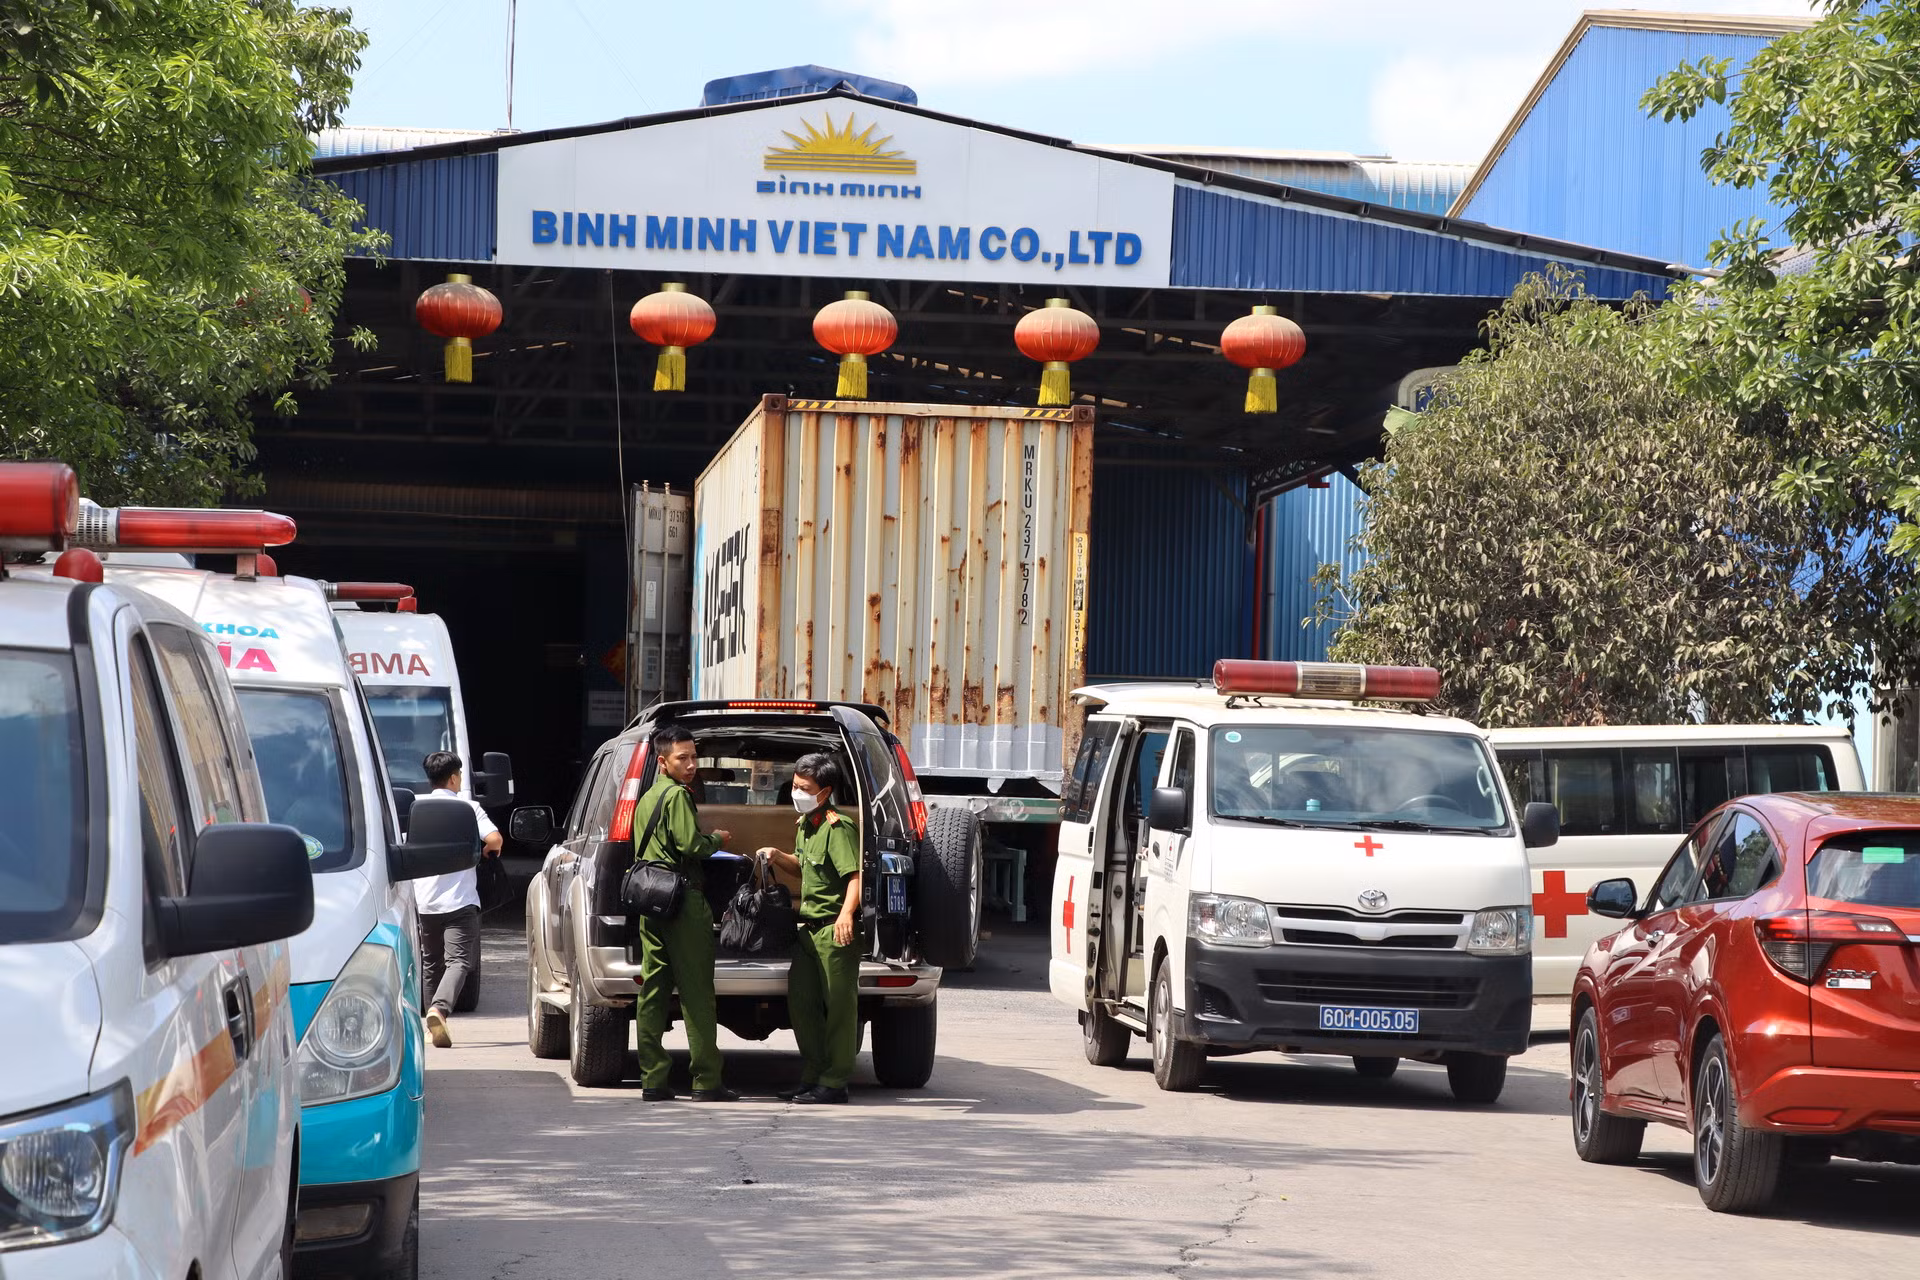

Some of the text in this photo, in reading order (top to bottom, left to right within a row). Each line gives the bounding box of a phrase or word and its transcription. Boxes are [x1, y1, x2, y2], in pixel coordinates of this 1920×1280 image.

[532, 210, 637, 248] BINH
[645, 215, 757, 253] MINH
[767, 220, 867, 257] VIET
[877, 224, 970, 260] NAM
[1024, 445, 1035, 508] MRKU
[1323, 1008, 1415, 1030] 60M-005.05
